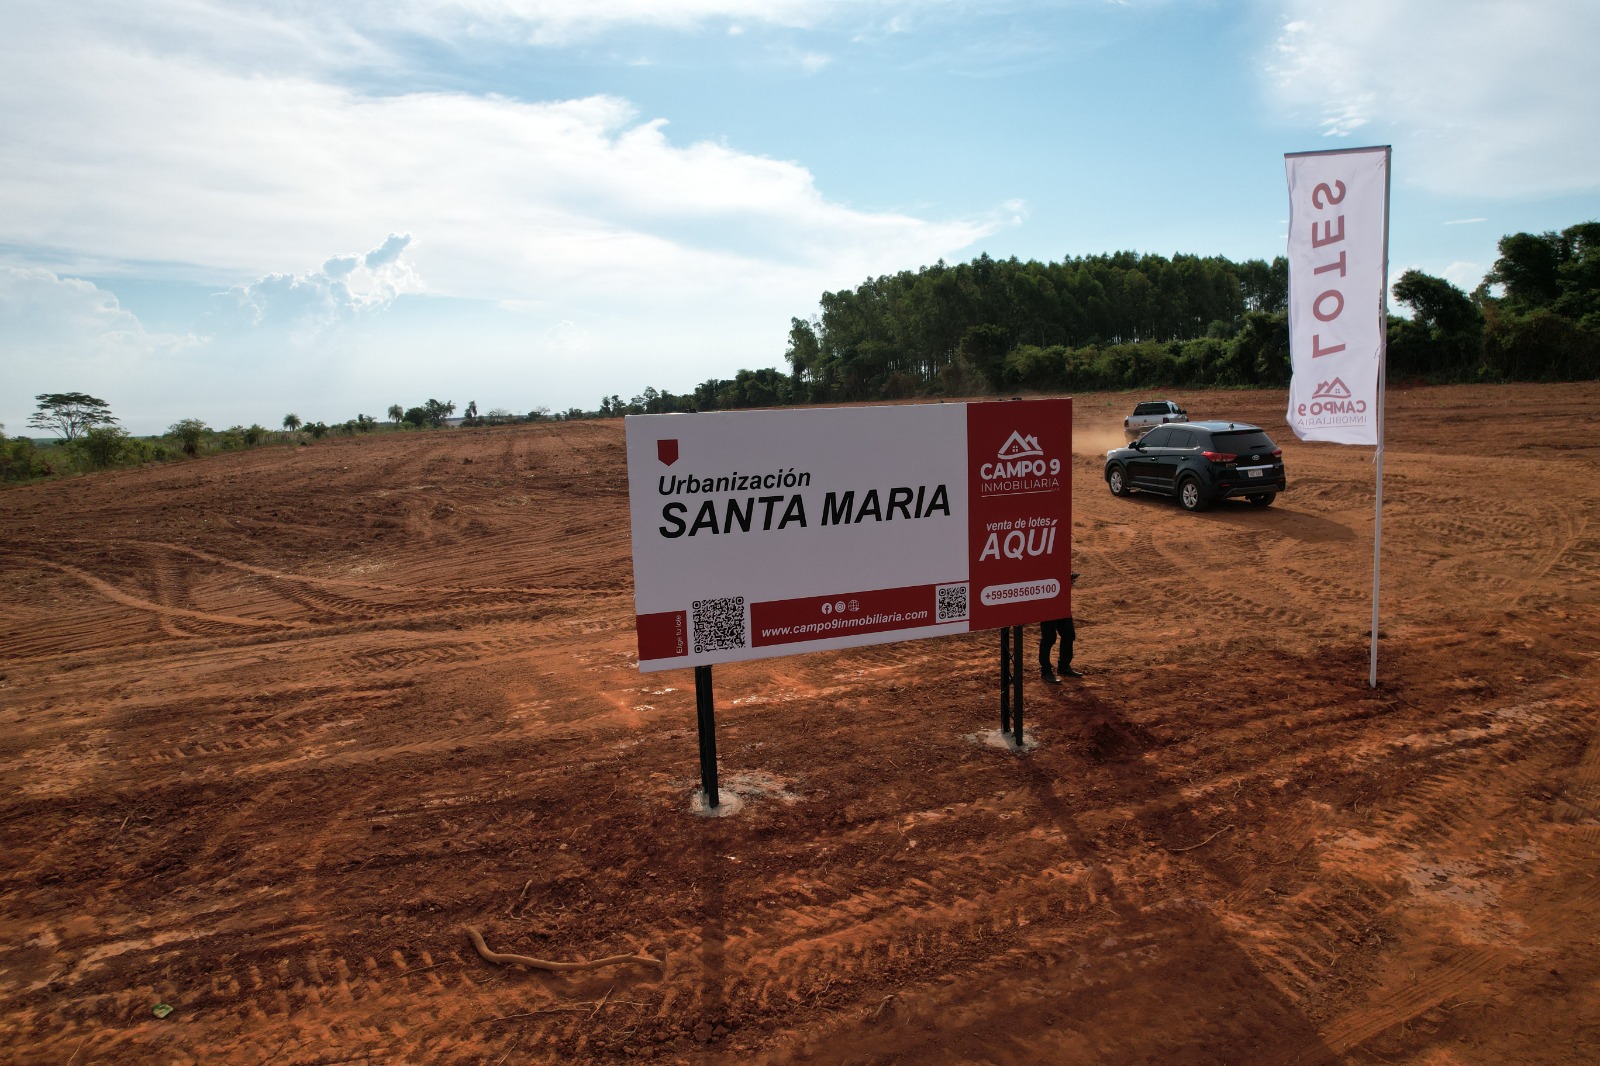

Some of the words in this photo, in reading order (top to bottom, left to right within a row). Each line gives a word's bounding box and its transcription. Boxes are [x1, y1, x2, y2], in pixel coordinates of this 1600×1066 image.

[658, 467, 811, 495] Urbanización
[980, 459, 1046, 480] CAMPO
[1049, 458, 1061, 475] 9
[981, 477, 1060, 493] INMOBILIARIA
[658, 494, 808, 539] SANTA
[821, 484, 951, 526] MARIA
[986, 519, 1012, 531] venta
[1014, 518, 1027, 529] de
[1028, 516, 1051, 527] lotes
[979, 519, 1059, 561] AQUÍ
[985, 583, 1057, 600] +595985605100
[761, 609, 929, 638] www.campo9inmobiliaria.com
